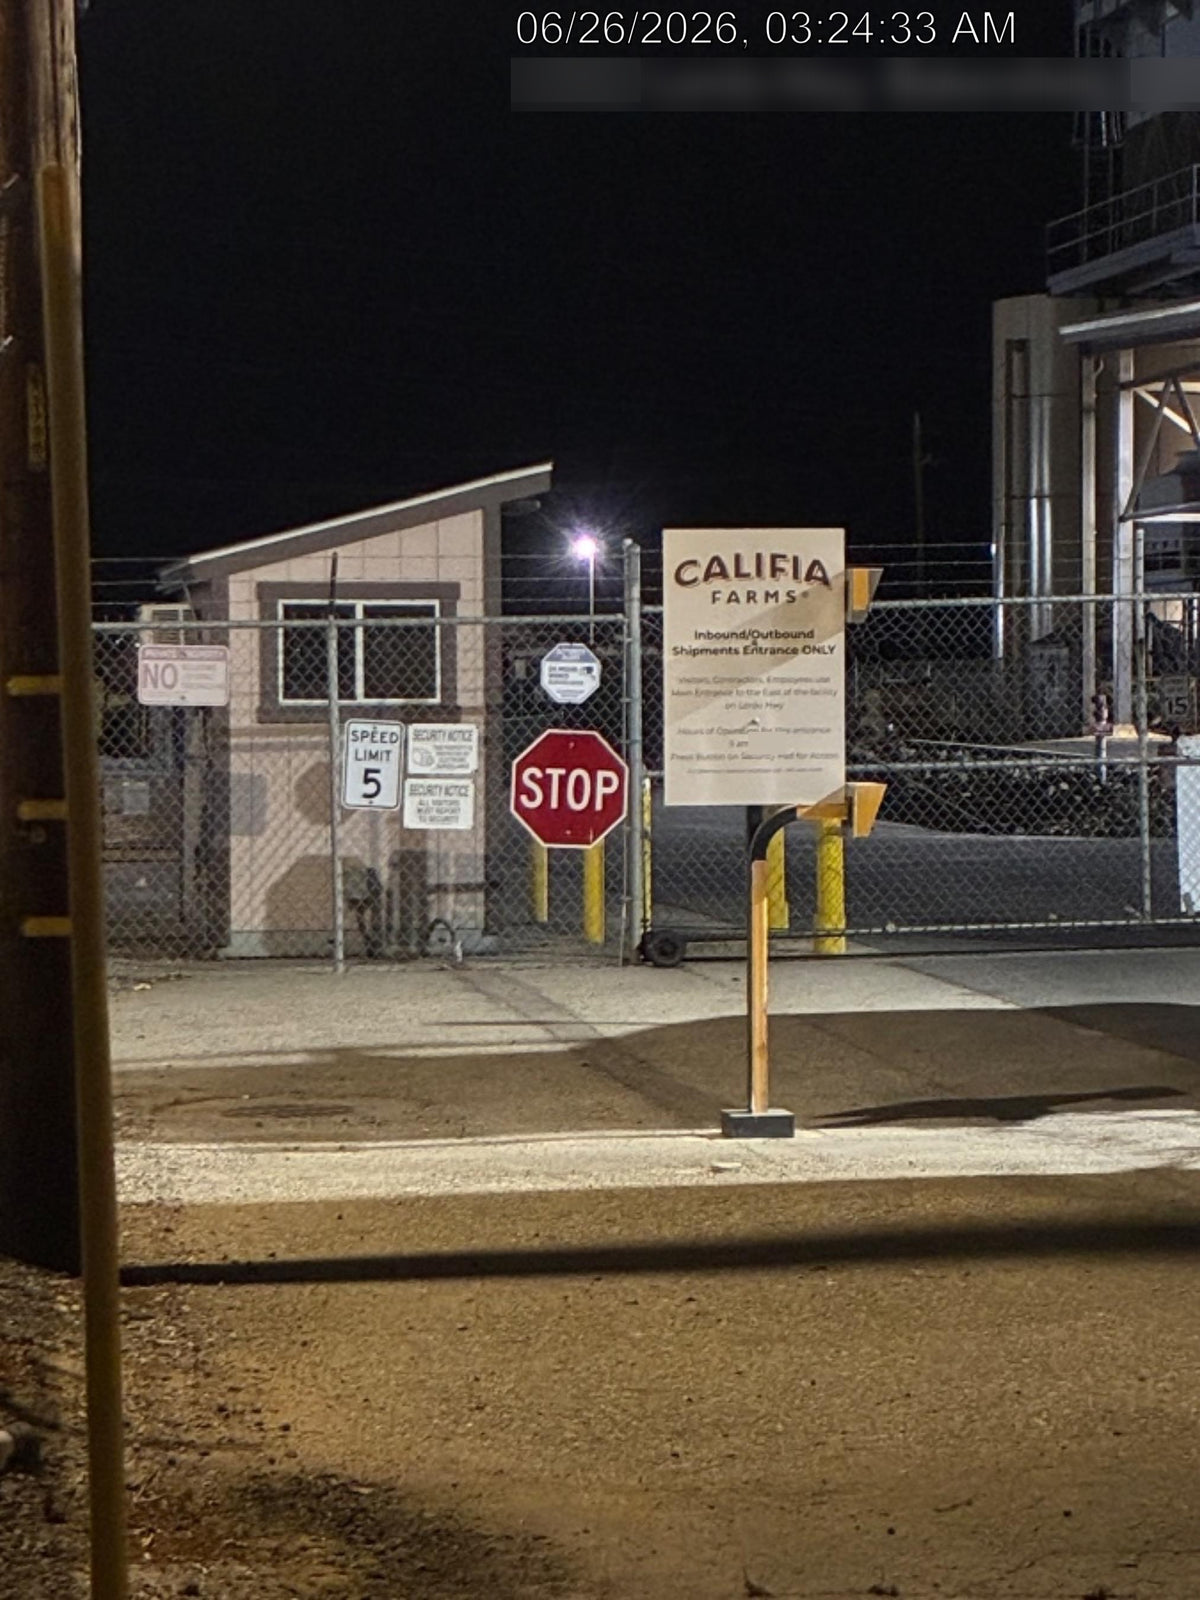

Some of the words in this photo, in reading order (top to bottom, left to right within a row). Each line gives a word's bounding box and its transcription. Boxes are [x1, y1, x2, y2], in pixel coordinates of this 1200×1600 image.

[674, 552, 832, 590] CALIFIA
[711, 589, 798, 604] FARMS
[694, 628, 815, 641] Inbound/Outbound
[672, 645, 740, 658] Shipments
[742, 645, 799, 655] Entrance
[801, 645, 837, 655] ONLY
[142, 662, 178, 690] NO
[351, 730, 399, 743] SPEED
[355, 749, 392, 761] LIMIT
[362, 767, 382, 799] 5
[520, 766, 620, 811] STOP
